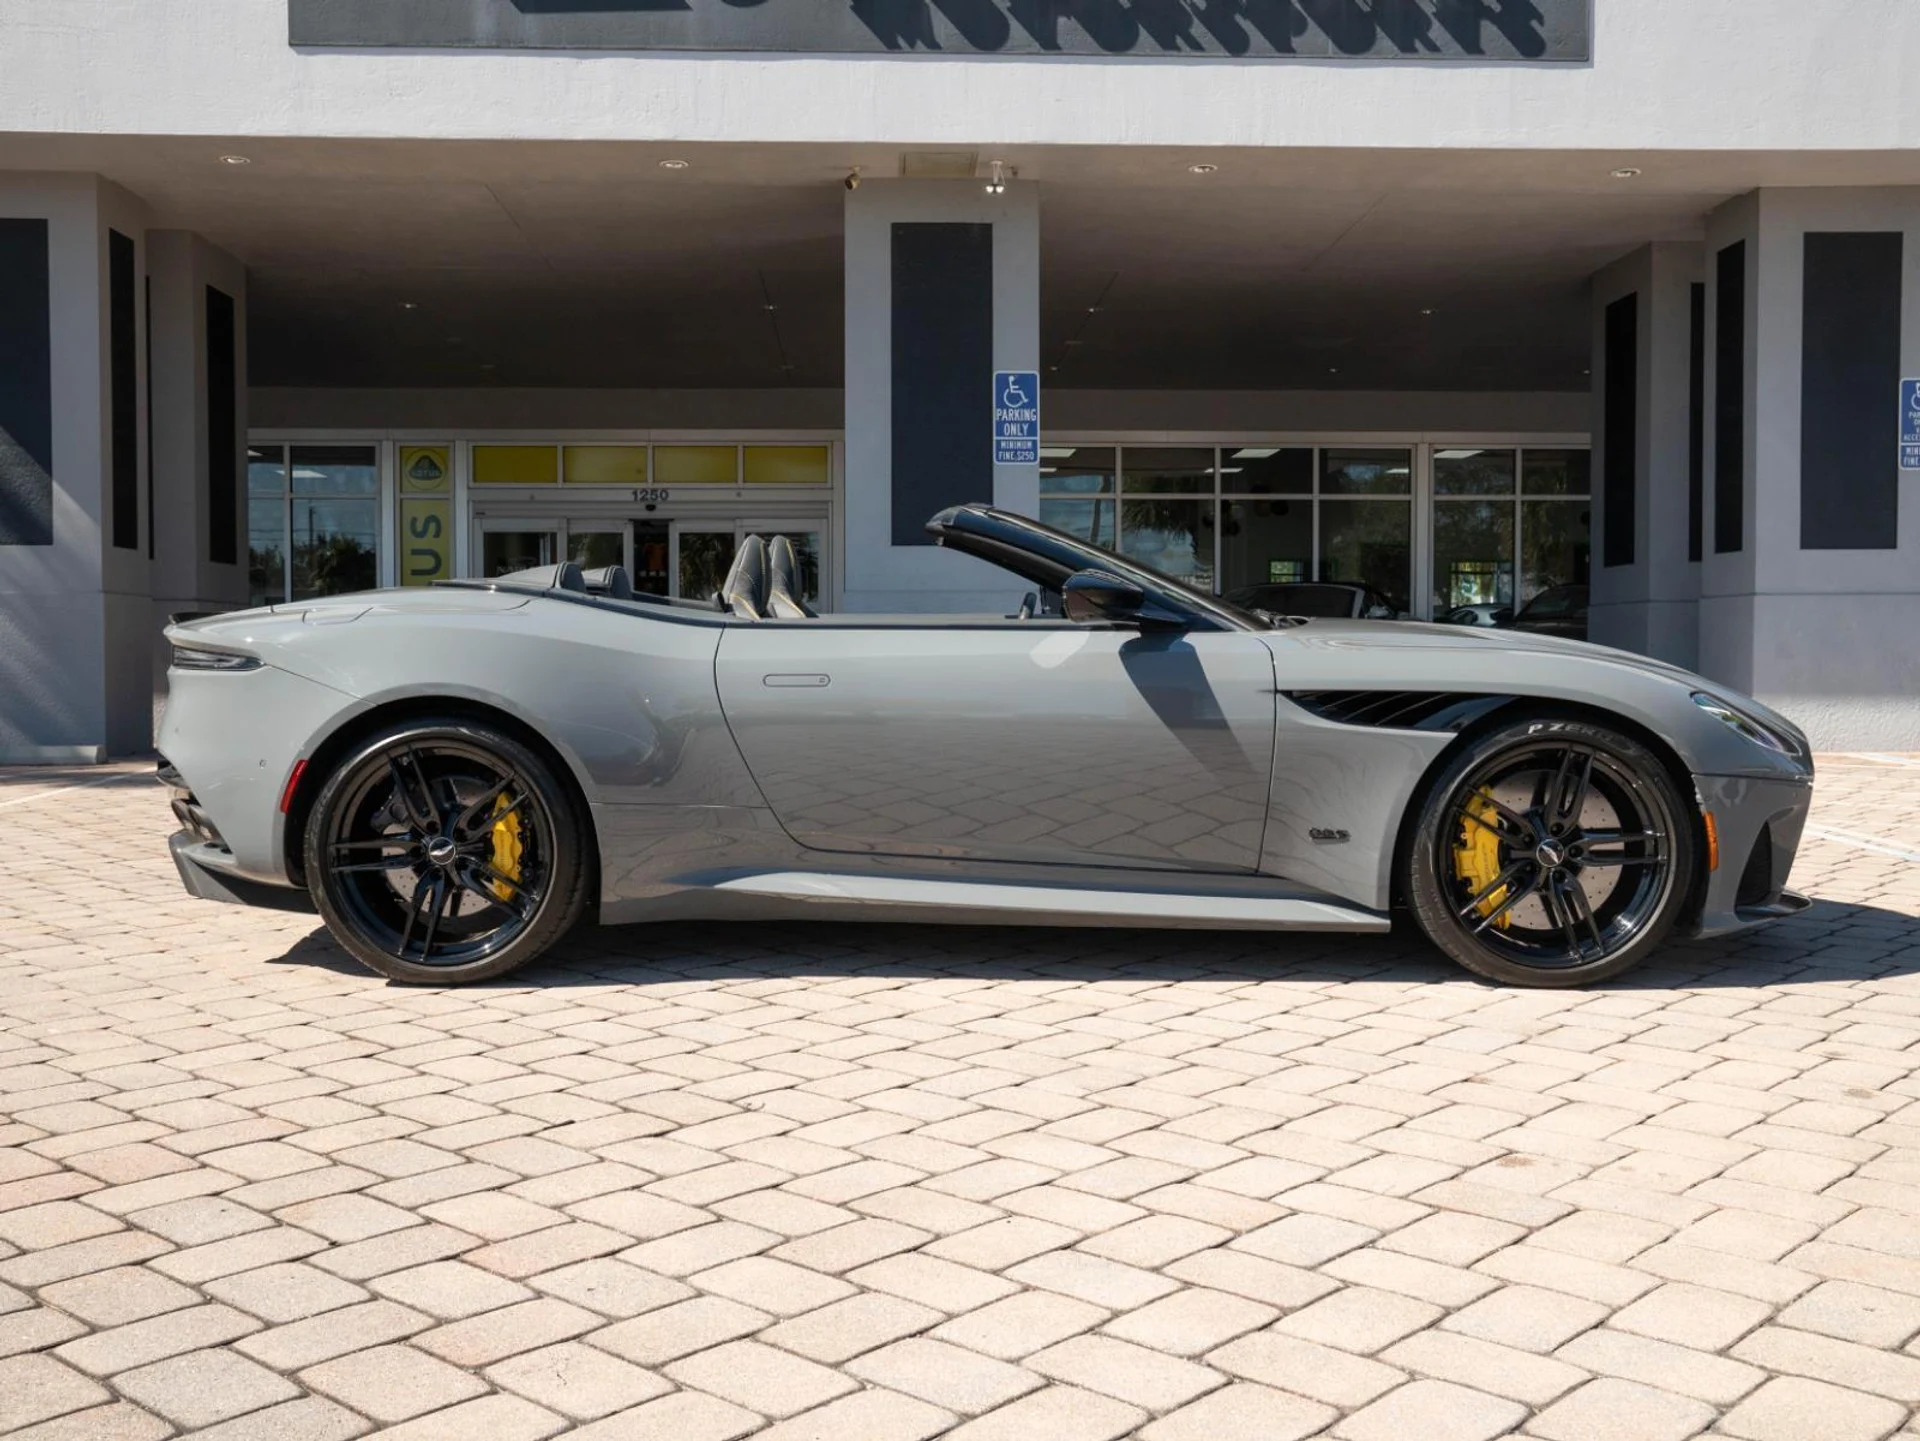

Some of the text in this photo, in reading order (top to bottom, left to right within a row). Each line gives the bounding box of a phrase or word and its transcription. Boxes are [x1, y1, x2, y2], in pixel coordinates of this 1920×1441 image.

[996, 408, 1037, 421] PARKING
[1004, 422, 1029, 436] ONLY
[1000, 440, 1033, 450] MINIMUM
[999, 451, 1014, 461] FINE
[632, 488, 669, 501] 1250
